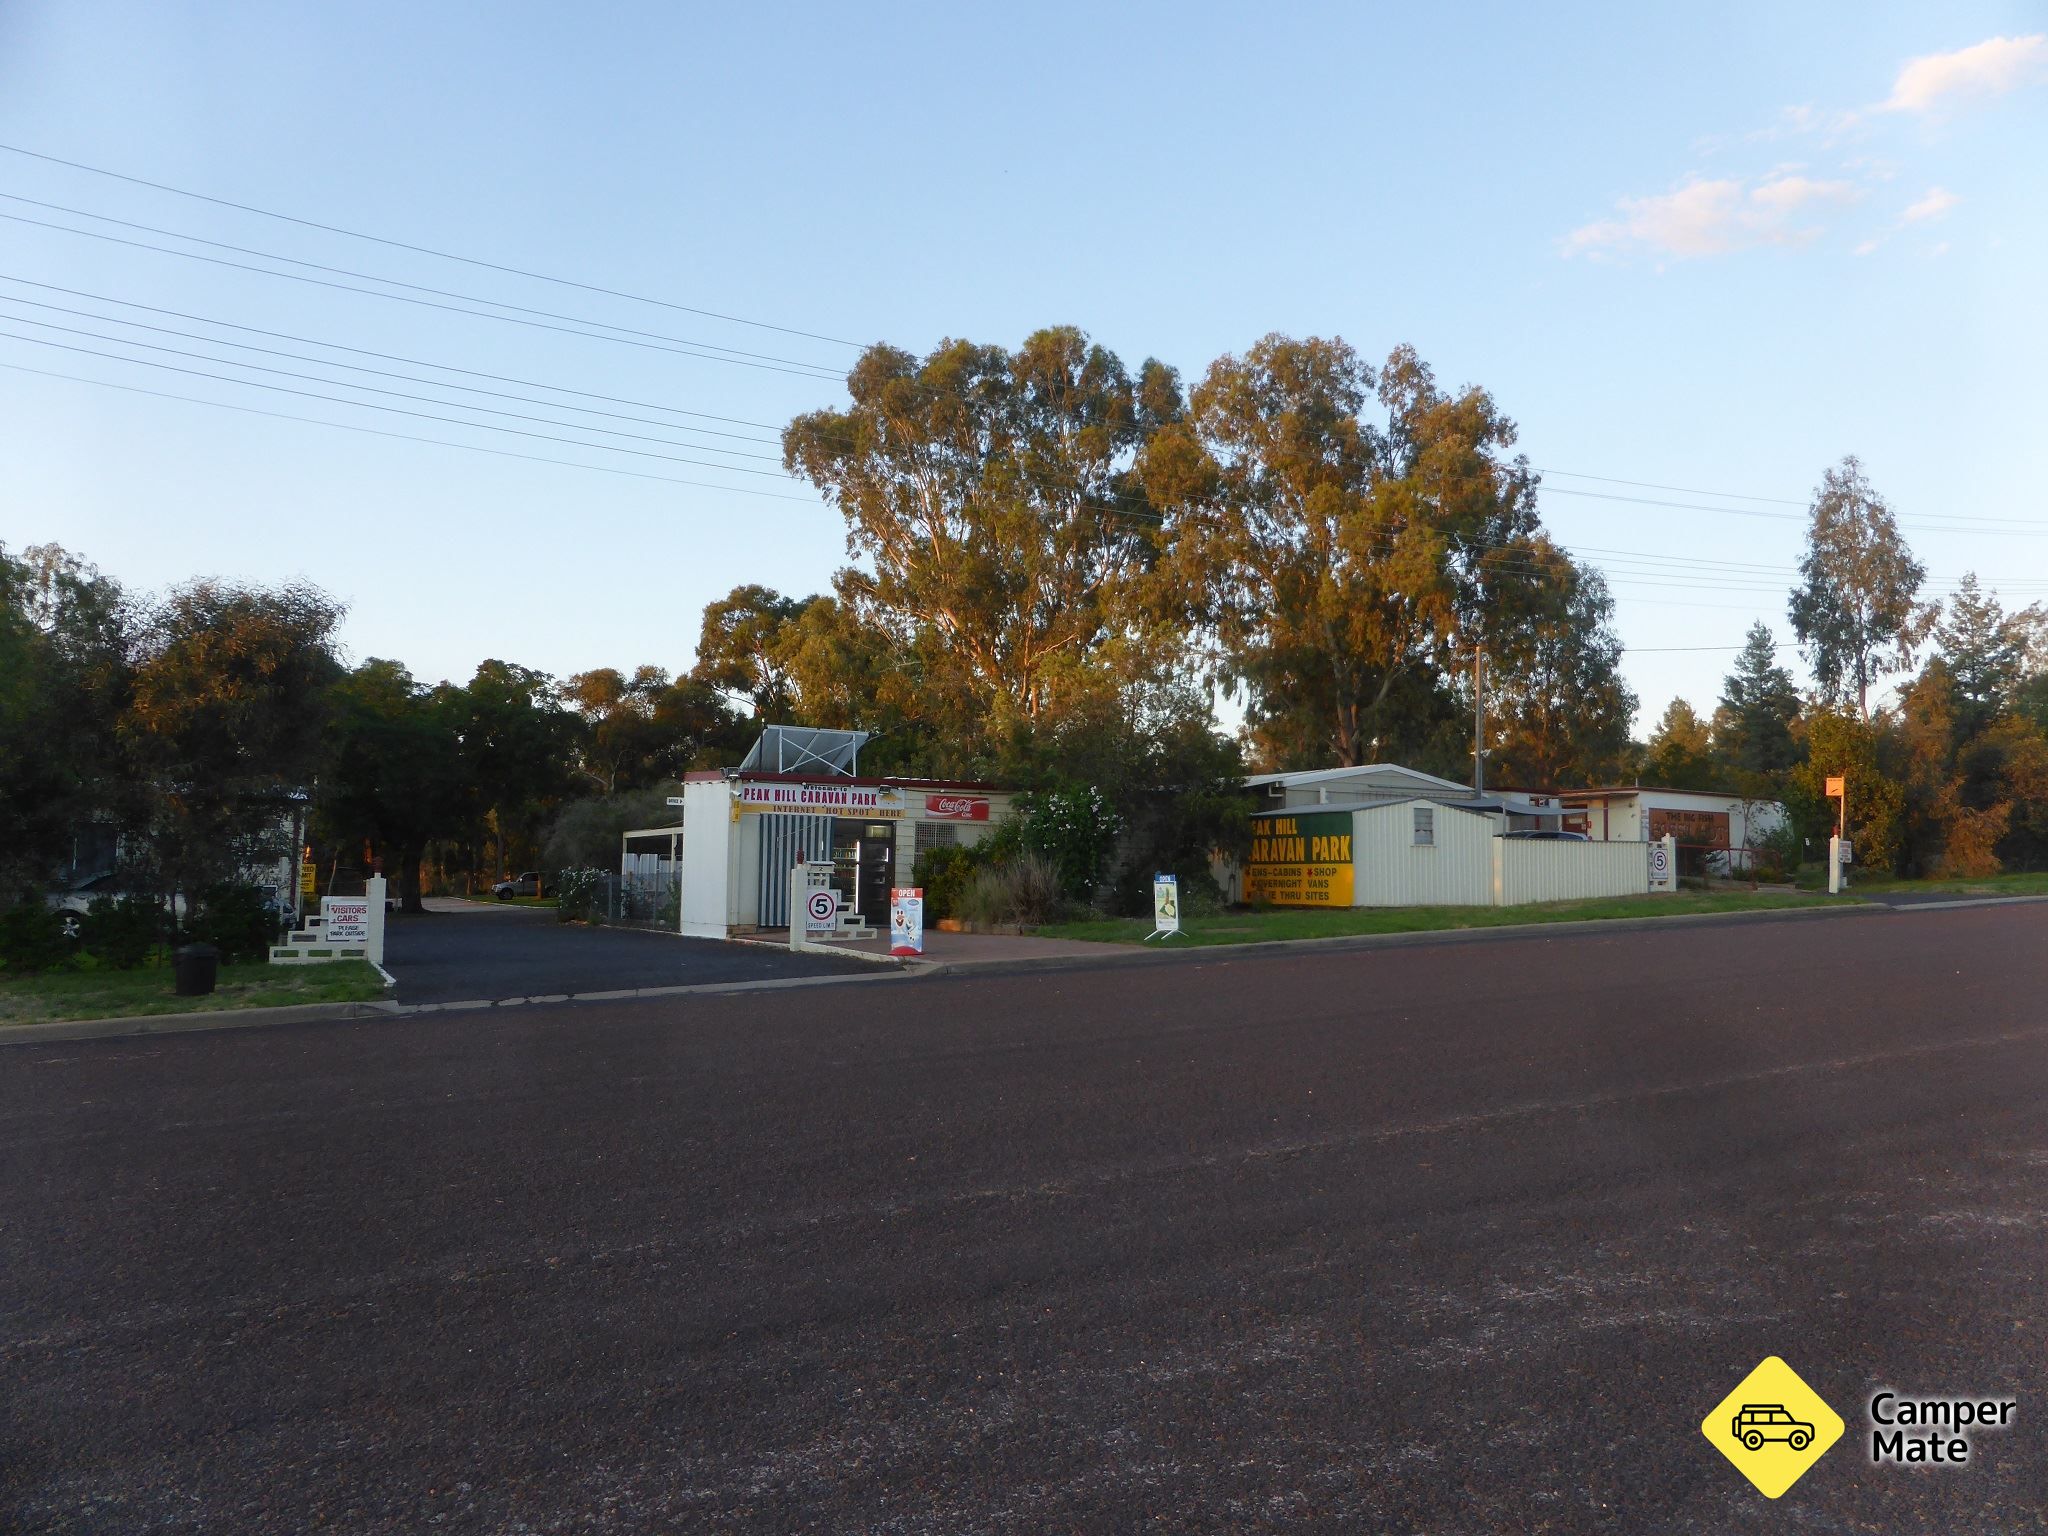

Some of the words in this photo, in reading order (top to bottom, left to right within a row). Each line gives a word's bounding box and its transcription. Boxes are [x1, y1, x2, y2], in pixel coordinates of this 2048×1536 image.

[743, 787, 770, 801] PEAK
[774, 789, 797, 803] HILL
[801, 790, 847, 805] CARAVAN
[851, 792, 877, 806] PARK
[773, 804, 816, 814] INTERNET
[879, 809, 902, 817] HERE
[1252, 819, 1271, 836] EAK
[1275, 818, 1298, 835] HILL
[1249, 837, 1305, 862] ARAVAN
[1312, 835, 1351, 861] PARK
[1656, 855, 1664, 867] 5
[1314, 867, 1337, 876] SHOP
[1308, 879, 1329, 888] VANS
[898, 889, 915, 897] OPEN
[1280, 891, 1301, 900] THRU
[1305, 891, 1329, 900] SITES
[332, 906, 367, 914] VISITORS
[815, 898, 828, 915] 5
[336, 914, 359, 922] CARS
